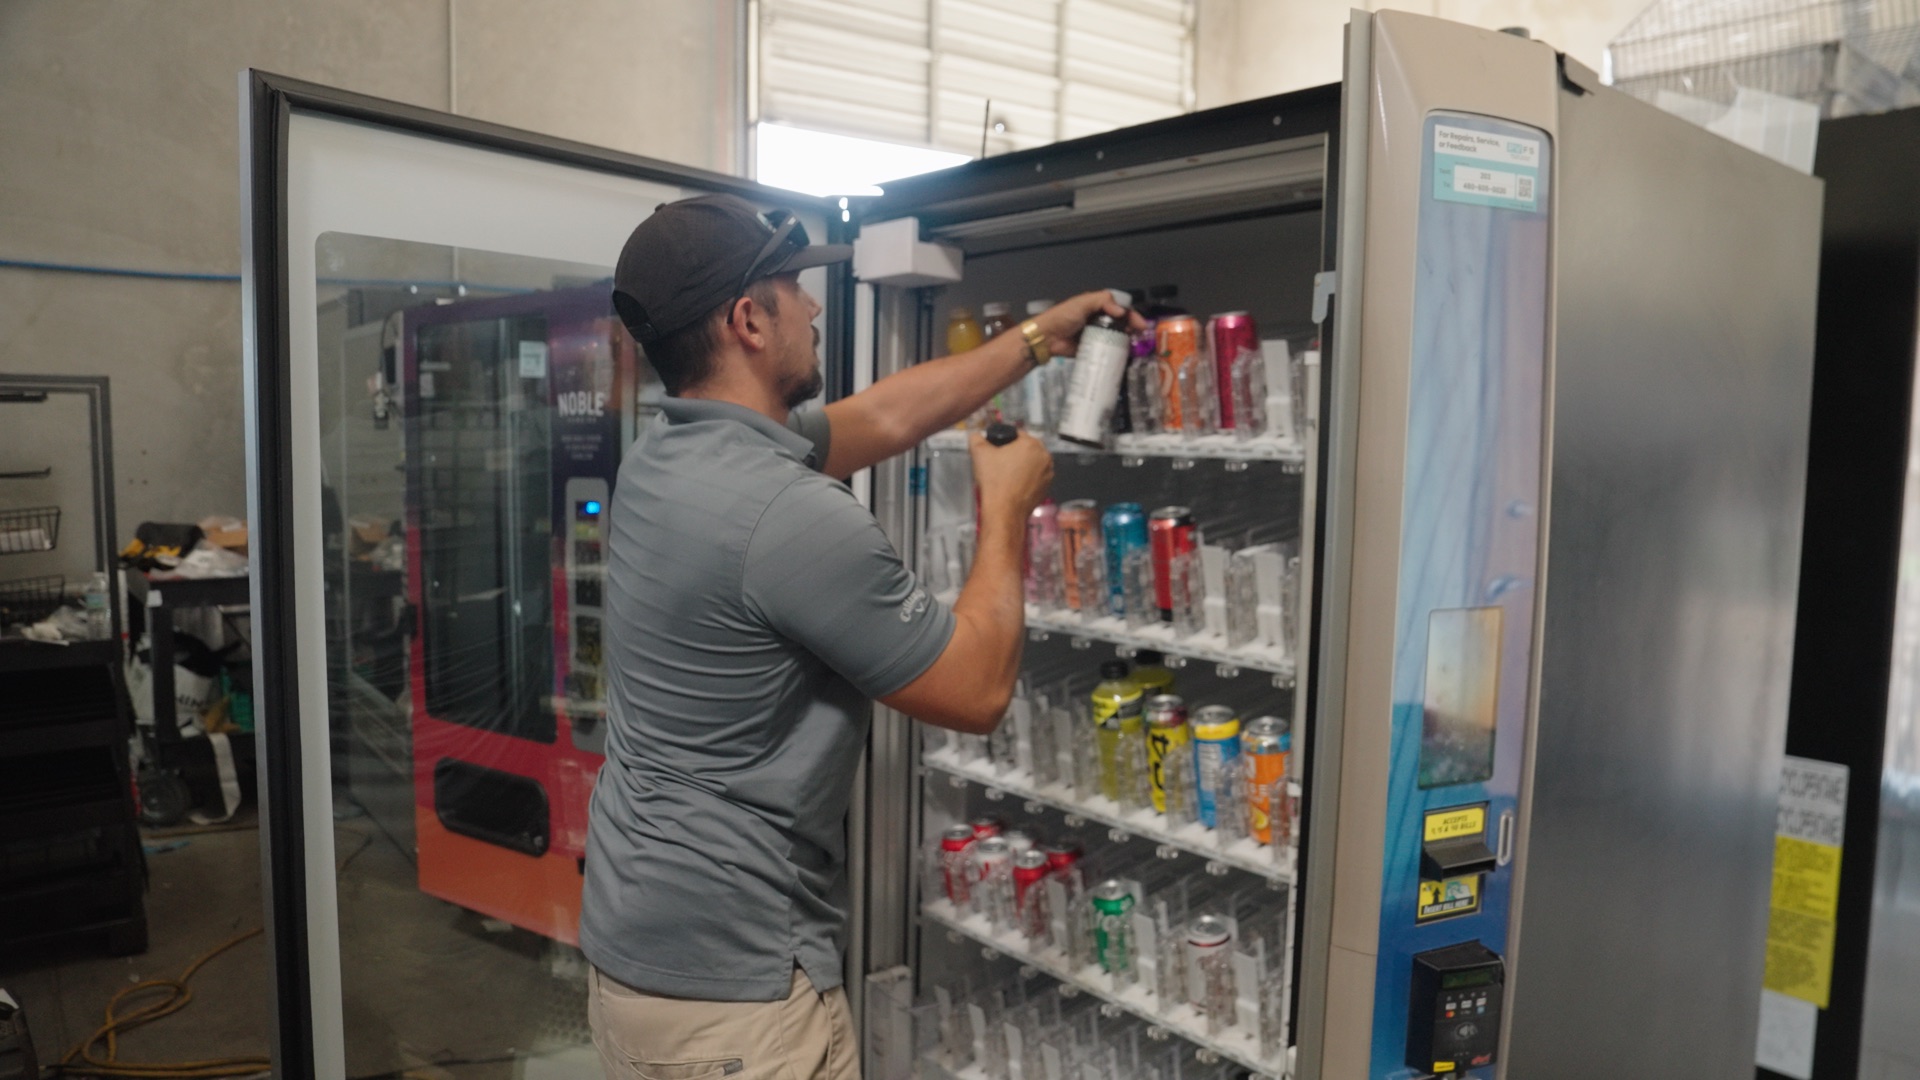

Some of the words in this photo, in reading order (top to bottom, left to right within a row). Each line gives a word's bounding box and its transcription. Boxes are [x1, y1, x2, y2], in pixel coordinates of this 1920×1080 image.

[1438, 130, 1449, 138] For
[1450, 131, 1475, 143] Repairs,
[1476, 136, 1501, 147] Service,
[1446, 141, 1477, 153] Feedback
[558, 391, 604, 416] NOBLE
[1443, 815, 1468, 825] ACCEPTS
[1424, 903, 1442, 914] INSERT
[1443, 900, 1454, 910] BILL
[1455, 898, 1469, 908] HERE
